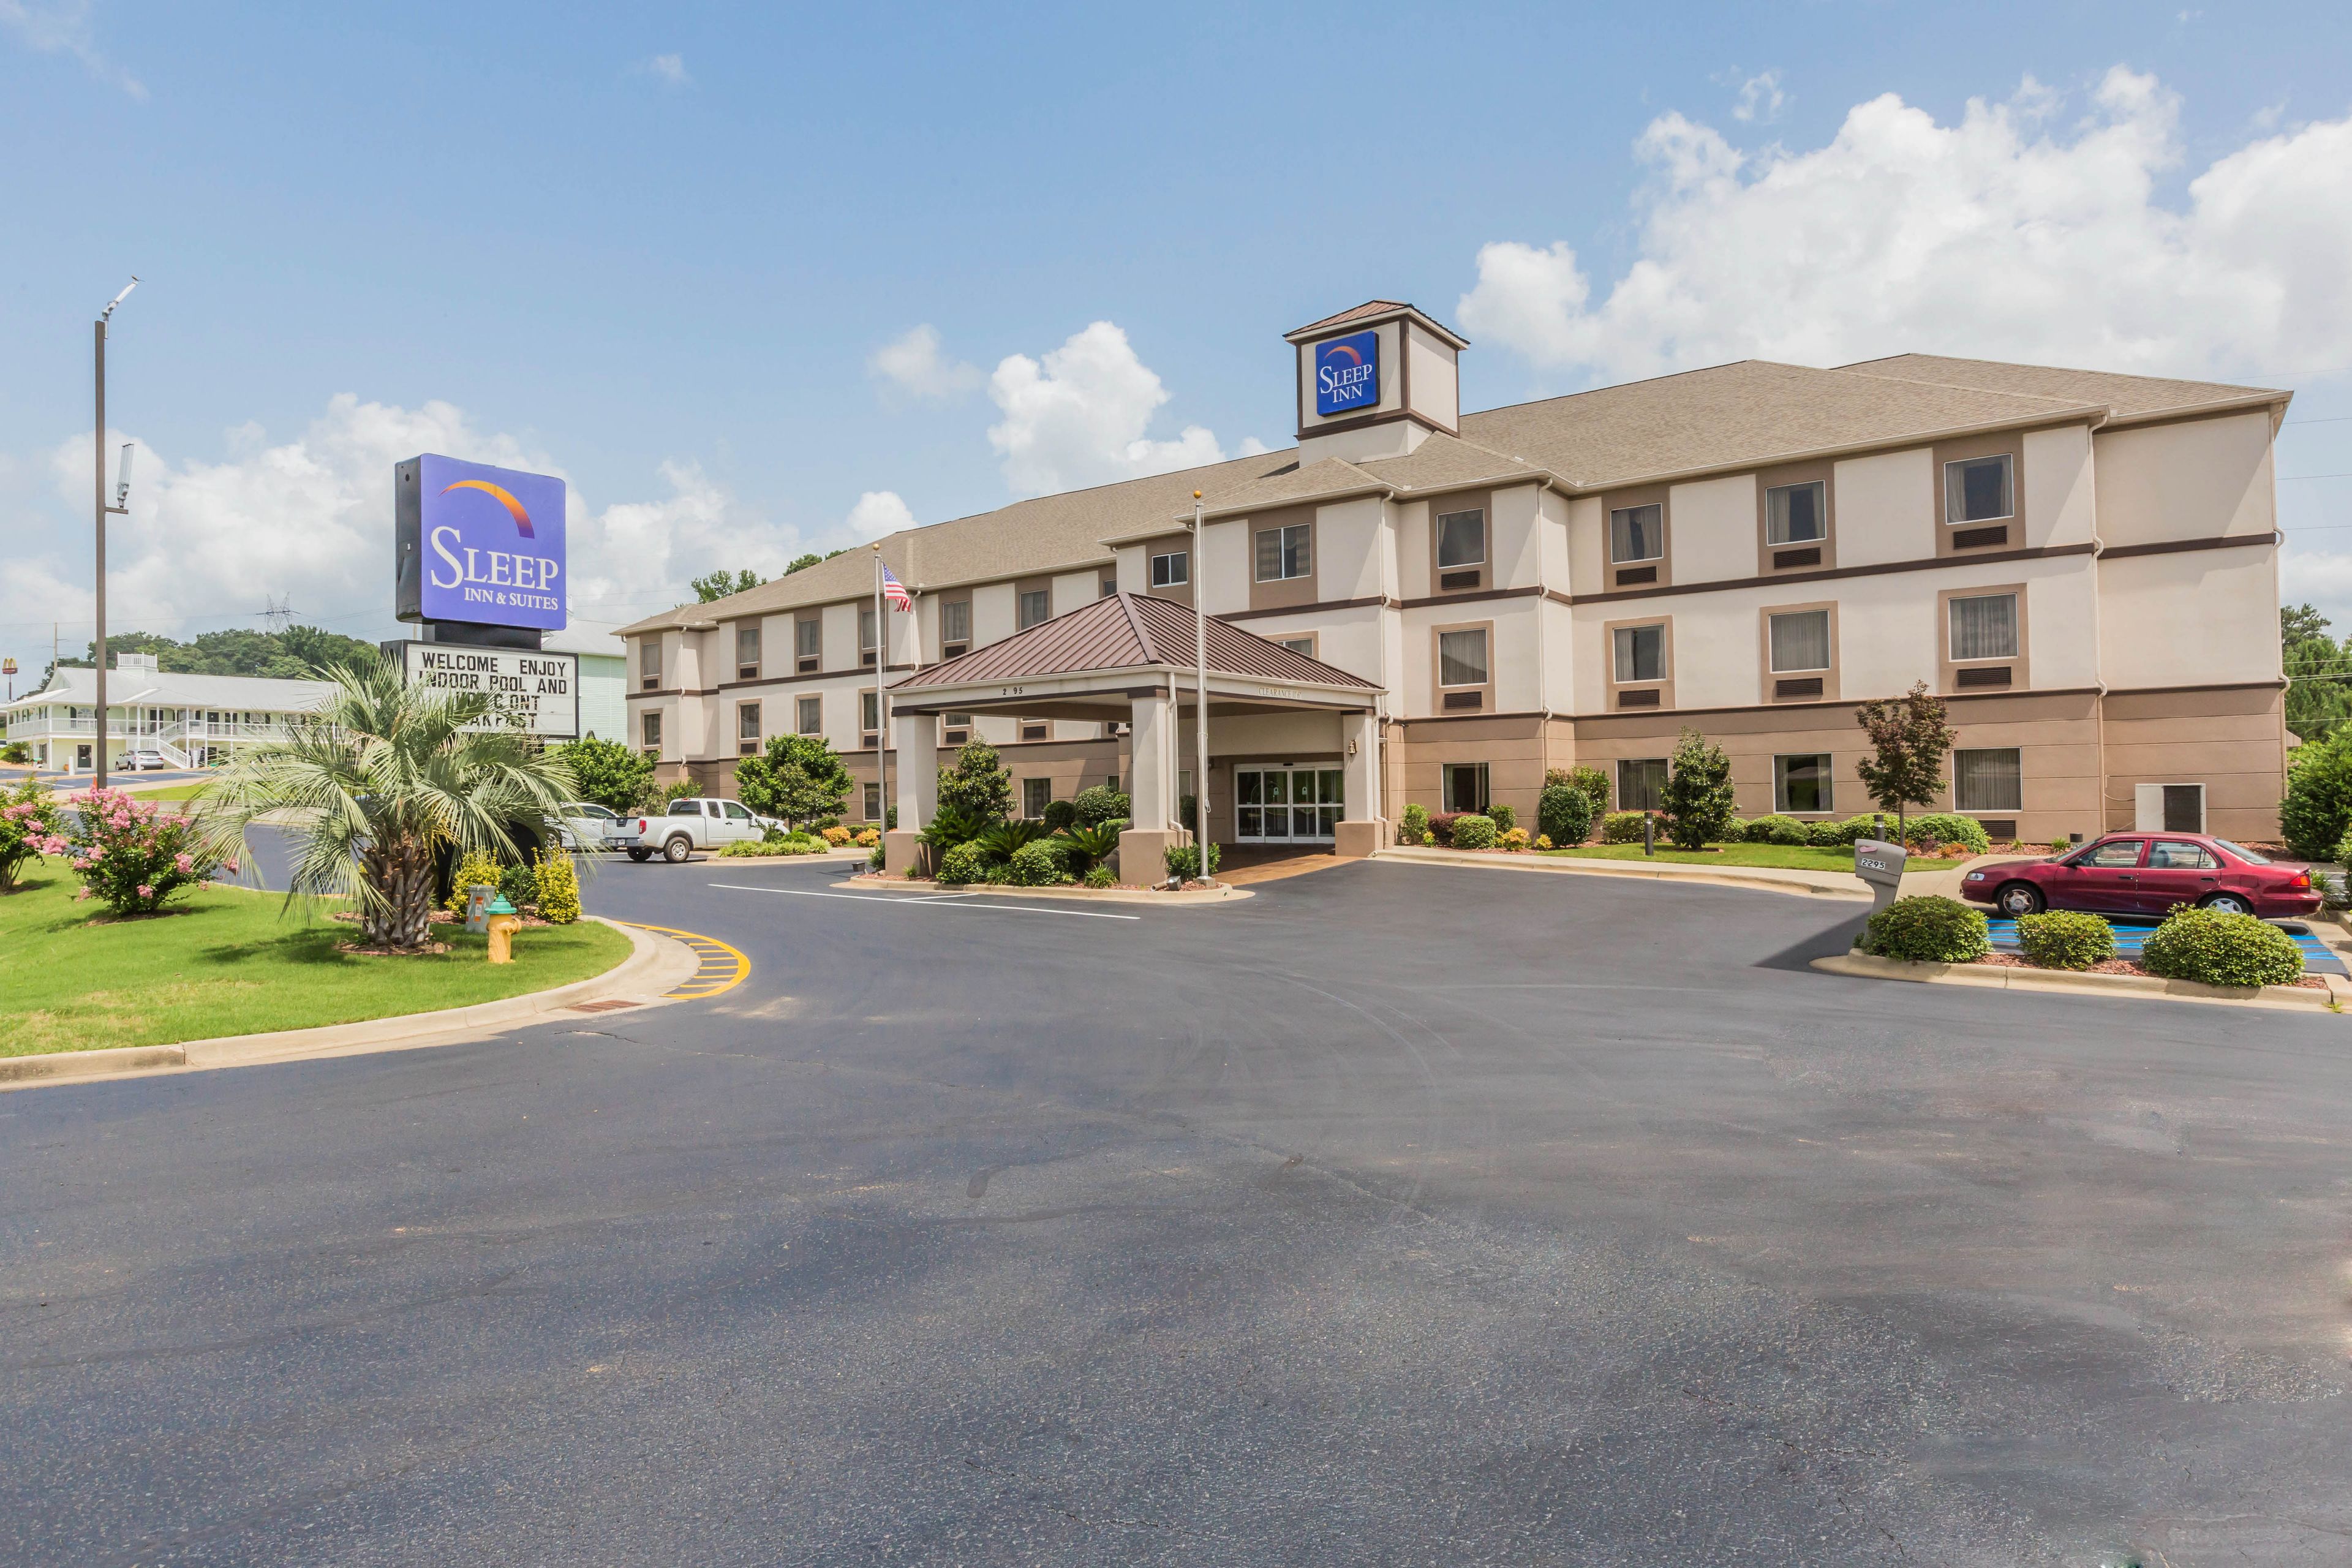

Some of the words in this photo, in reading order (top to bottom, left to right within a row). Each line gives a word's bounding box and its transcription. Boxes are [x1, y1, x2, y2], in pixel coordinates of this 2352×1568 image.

[1320, 364, 1373, 394] SLEEP
[1332, 384, 1363, 403] INN
[431, 526, 559, 590] SLEEP
[464, 587, 494, 603] INN
[496, 592, 507, 605] &
[509, 593, 559, 611] SUITES
[422, 652, 499, 673] WELCOME
[520, 659, 567, 677] ENJOY
[489, 675, 527, 692] POOL
[537, 678, 567, 695] AND
[1259, 687, 1291, 698] CLEARANCE
[1862, 859, 1885, 869] 2295
